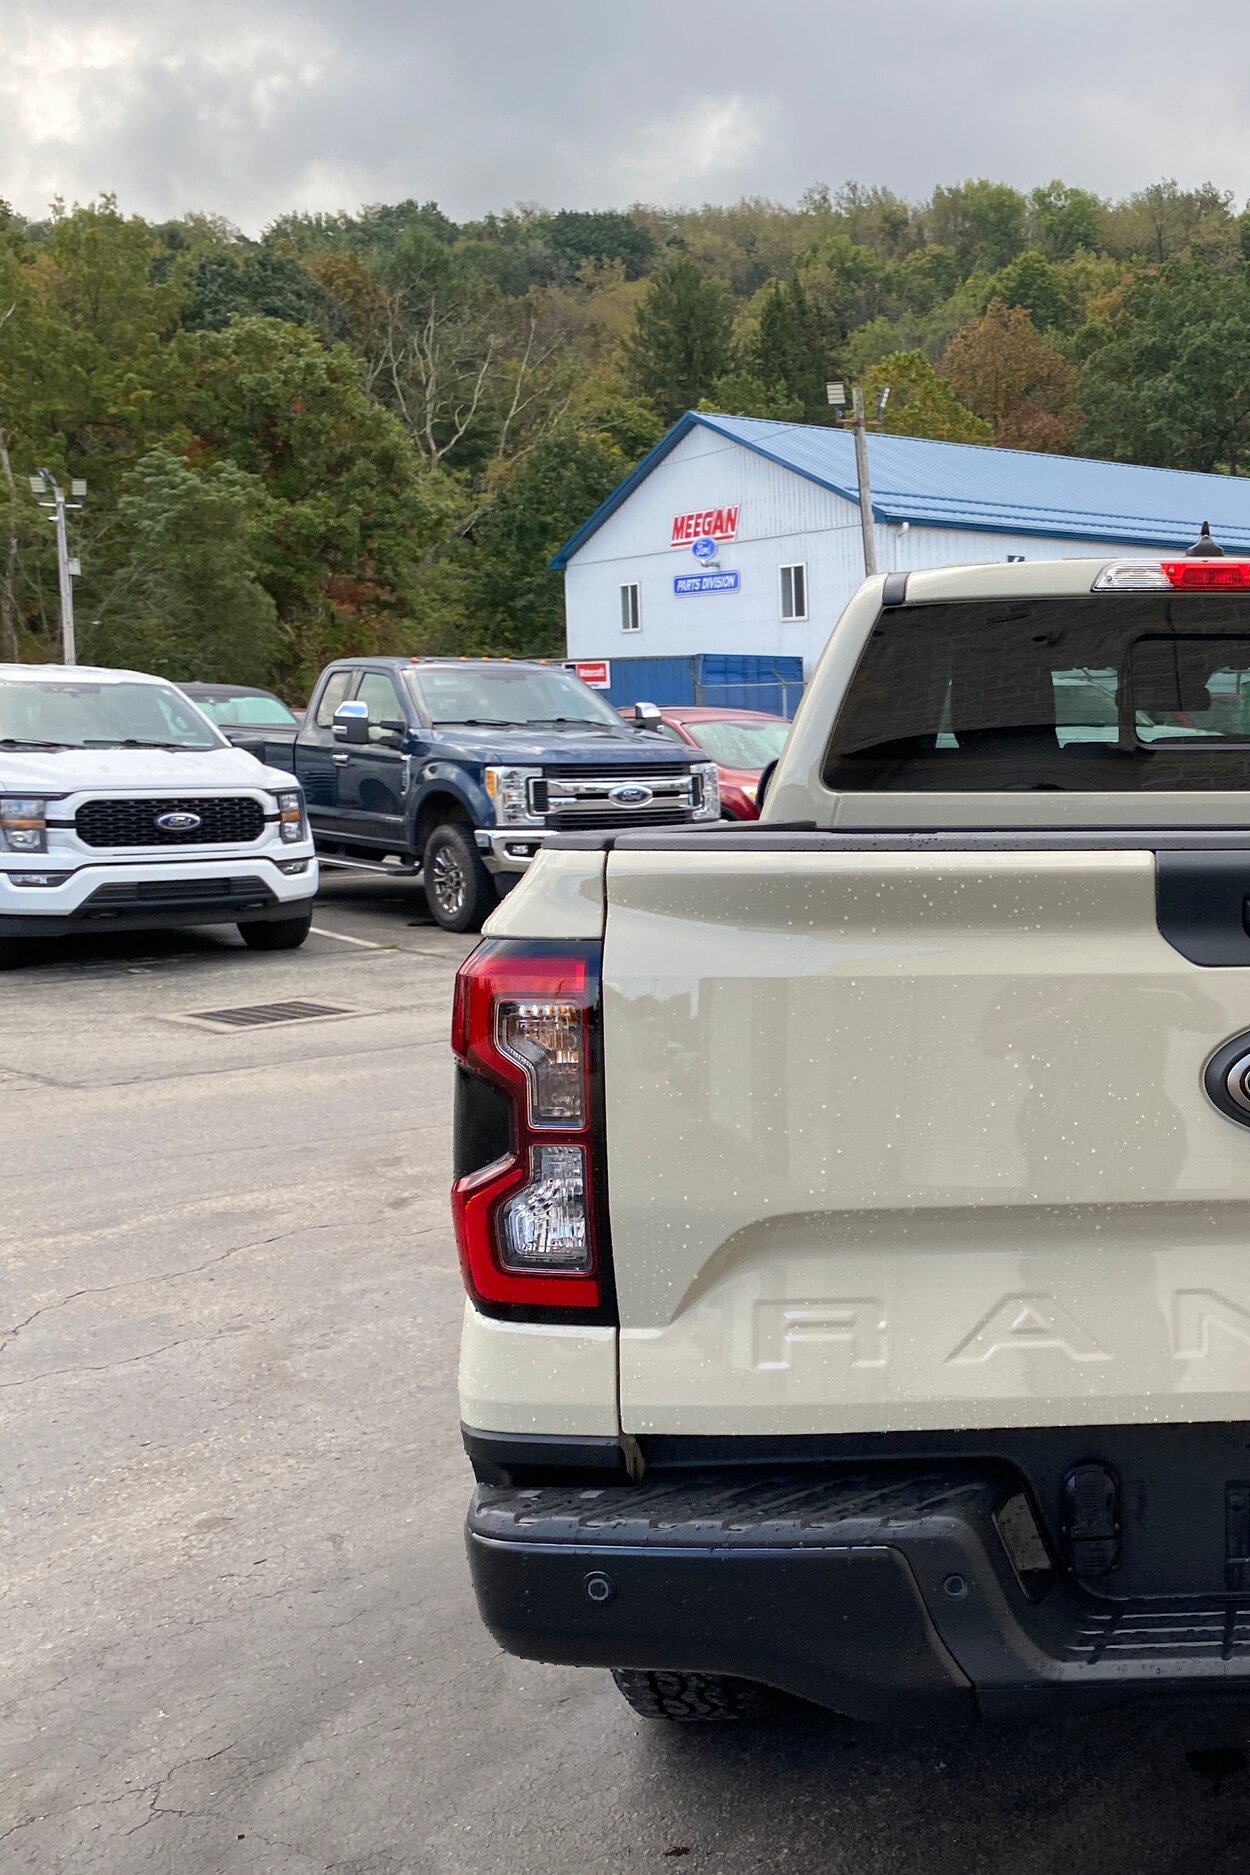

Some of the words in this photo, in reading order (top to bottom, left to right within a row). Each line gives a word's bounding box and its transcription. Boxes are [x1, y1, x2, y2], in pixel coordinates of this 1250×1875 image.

[672, 506, 739, 541] MEEGAN
[676, 577, 701, 592] PARTS
[702, 574, 735, 590] DIVISION
[621, 790, 645, 801] Ford
[168, 816, 192, 827] Ford
